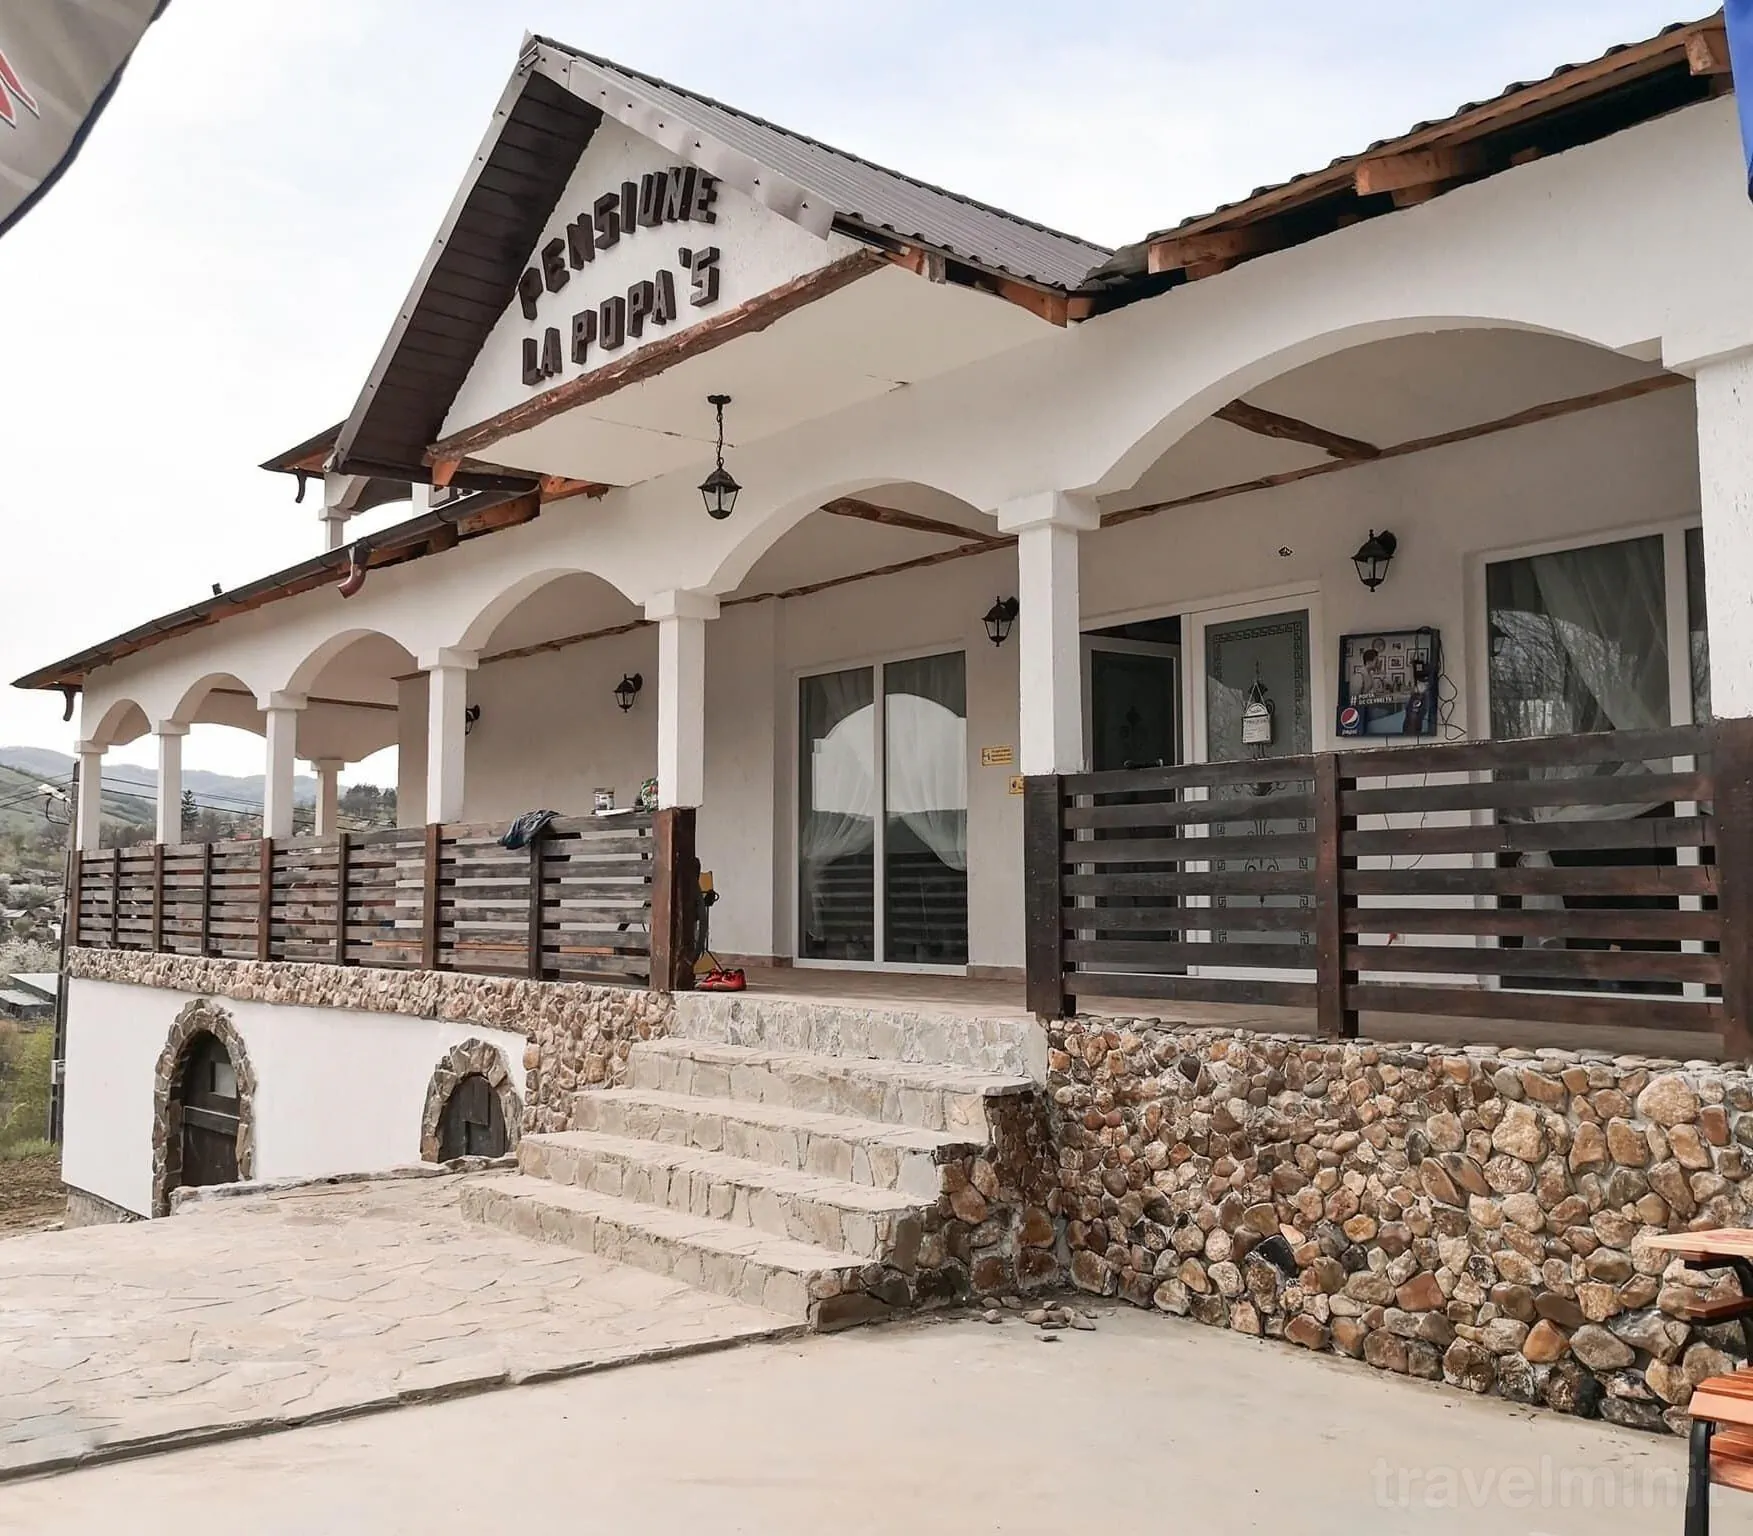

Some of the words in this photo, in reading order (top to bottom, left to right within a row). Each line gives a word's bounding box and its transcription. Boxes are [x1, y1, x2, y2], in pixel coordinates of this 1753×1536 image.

[518, 166, 718, 321] PENSIUNE
[522, 327, 563, 386] LA
[571, 246, 720, 365] POPA'S
